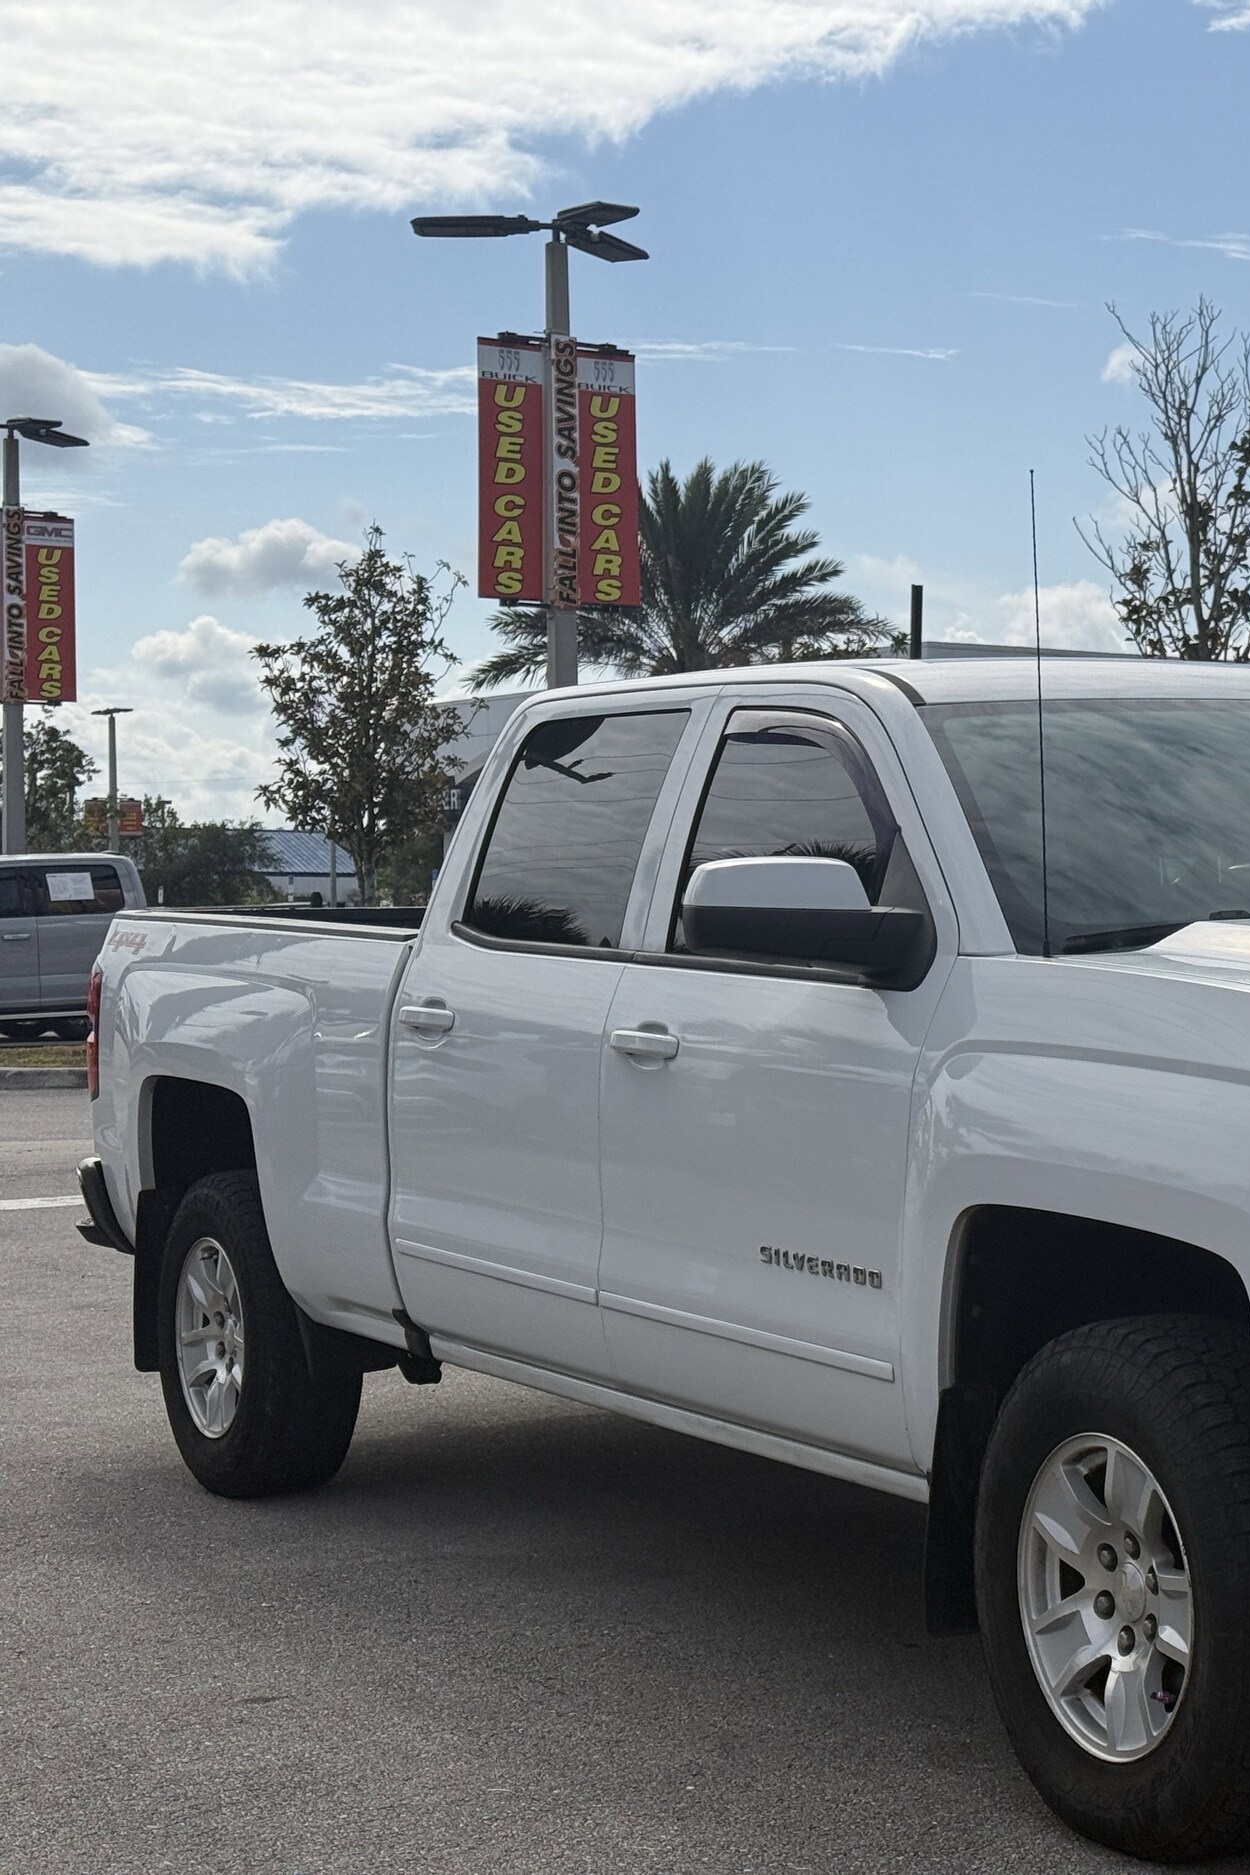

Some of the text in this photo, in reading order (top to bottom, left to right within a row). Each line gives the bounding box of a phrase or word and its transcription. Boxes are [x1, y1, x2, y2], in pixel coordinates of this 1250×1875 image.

[481, 370, 538, 384] BUICK
[577, 382, 632, 394] BUICK
[491, 383, 526, 595] USED CARS
[555, 338, 577, 605] FALL INTO SAVINGS
[589, 395, 623, 602] USED CARS
[26, 525, 73, 538] GMC
[6, 508, 24, 700] FALL INTO SAVINGS
[37, 548, 63, 620] USED
[37, 626, 63, 698] CARS
[759, 1245, 883, 1289] SILVERADO
